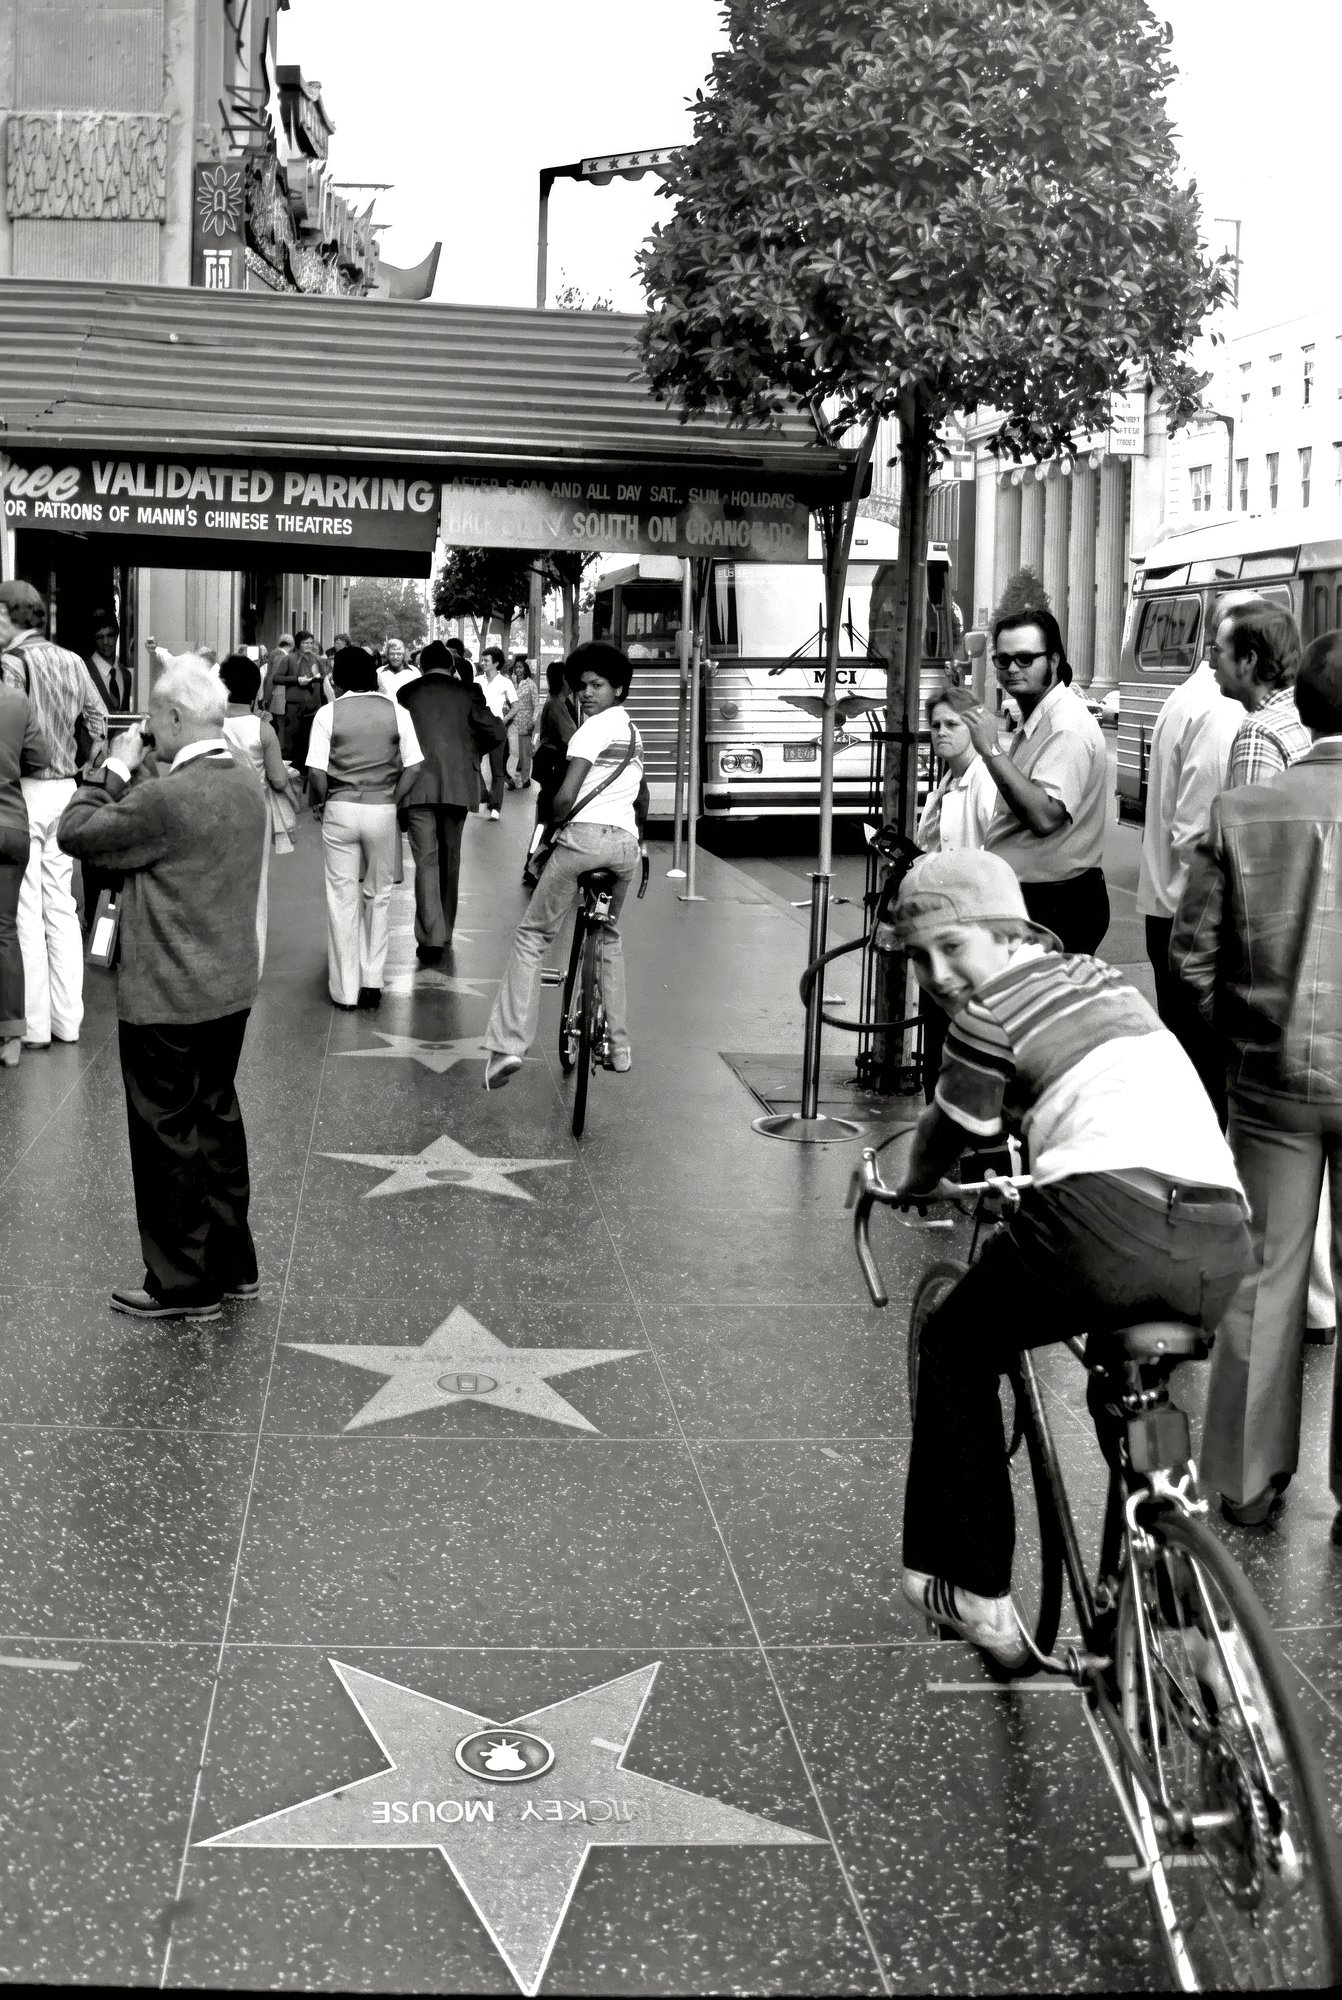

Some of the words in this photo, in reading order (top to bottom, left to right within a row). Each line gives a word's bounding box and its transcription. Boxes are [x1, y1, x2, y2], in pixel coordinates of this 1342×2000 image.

[92, 461, 273, 503] VALIDATED
[284, 471, 434, 513] PARKING
[551, 481, 582, 499] AND
[586, 483, 610, 500] ALL
[617, 484, 642, 501] DAY
[731, 490, 795, 509] HOLIDAYS
[3, 500, 27, 517] OR
[34, 501, 102, 522] PATRONS
[109, 506, 129, 523] OF
[137, 504, 197, 526] MANN'S
[205, 510, 268, 531] CHINESE
[276, 514, 353, 535] THEATRES
[572, 512, 639, 541] SOUTH
[648, 516, 677, 543] ON
[814, 670, 857, 684] MCI
[372, 1800, 494, 1823] MOUSE
